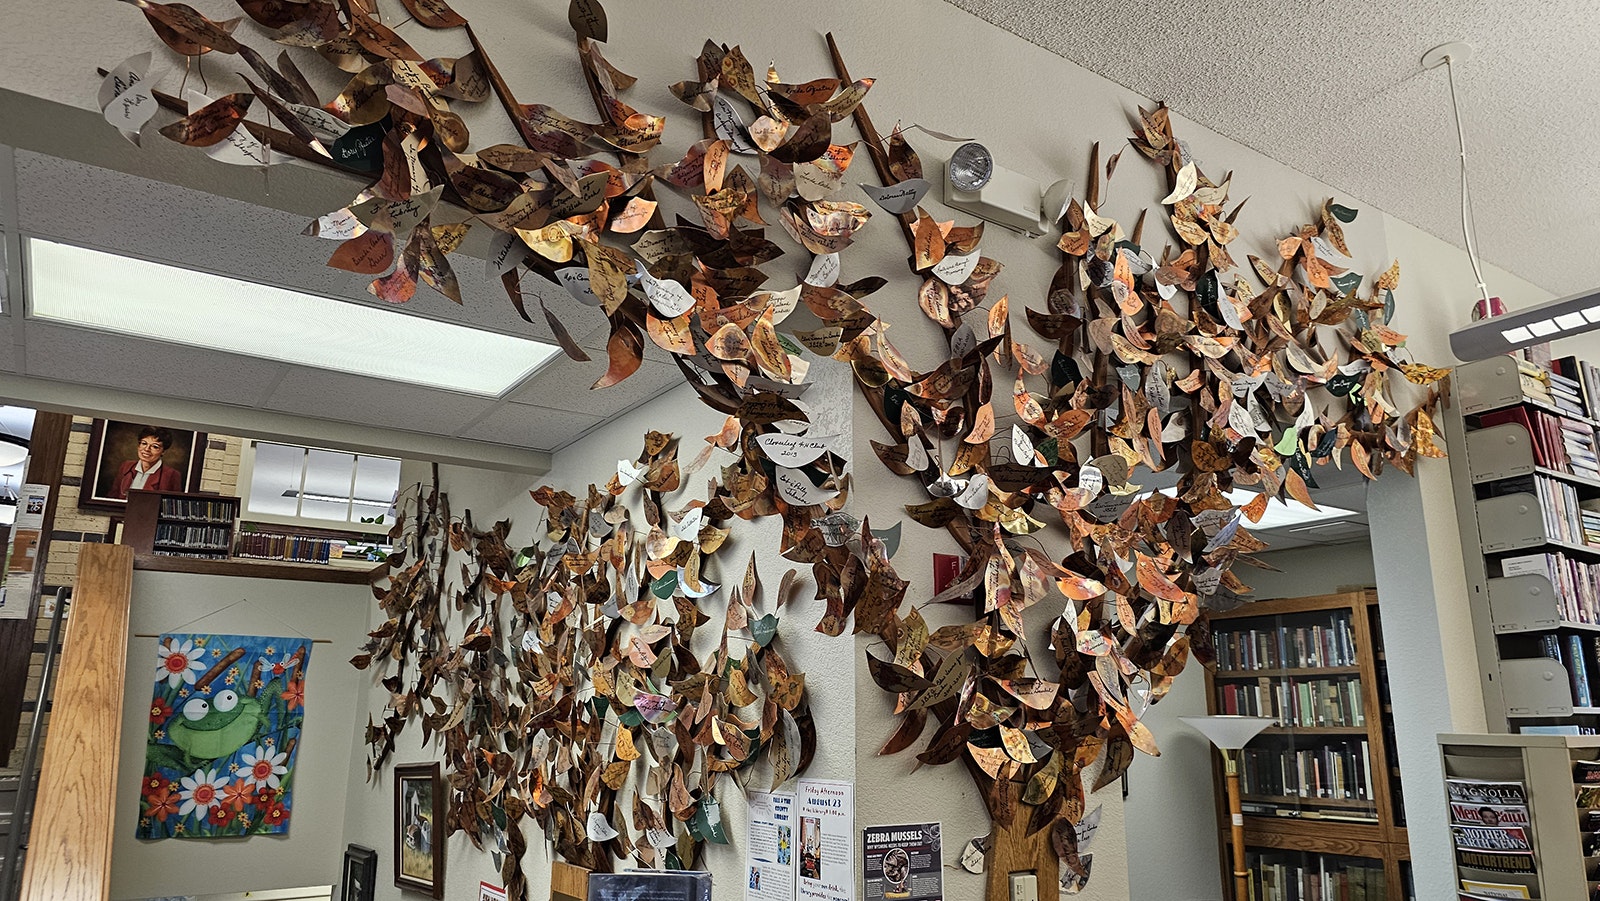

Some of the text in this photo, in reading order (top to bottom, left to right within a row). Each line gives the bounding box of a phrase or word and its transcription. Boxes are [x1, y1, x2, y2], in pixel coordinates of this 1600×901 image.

[805, 785, 844, 796] Friday Afternoon
[1451, 786, 1521, 799] MAGNOLIA
[833, 799, 842, 807] 23
[866, 830, 923, 844] ZEBRA MUSSELS
[1464, 828, 1508, 840] MOTHER
[1455, 836, 1528, 850] EARTH NEWS
